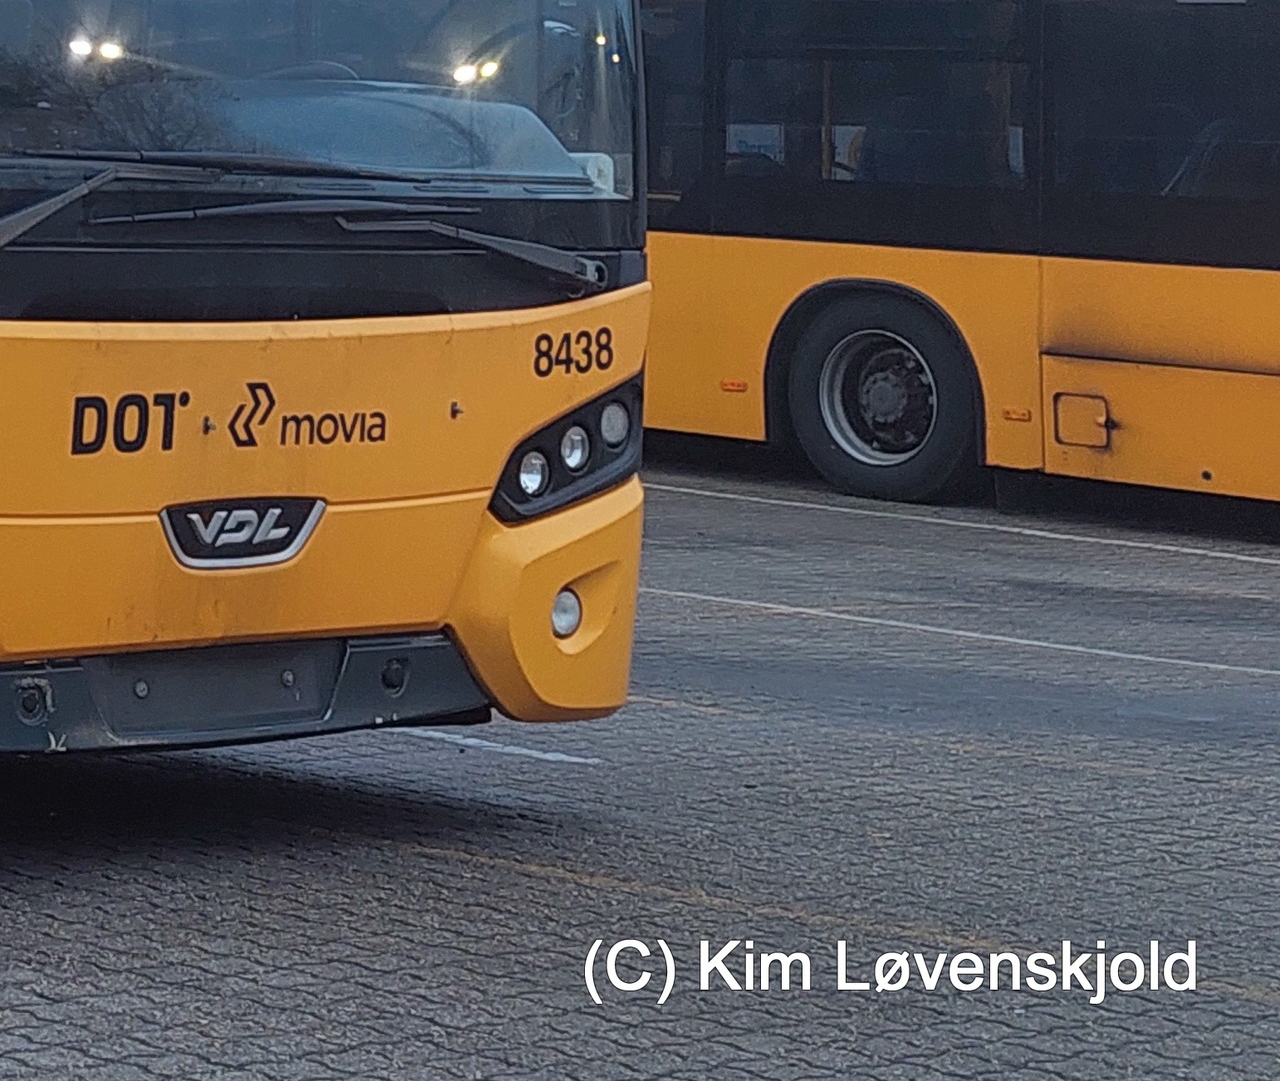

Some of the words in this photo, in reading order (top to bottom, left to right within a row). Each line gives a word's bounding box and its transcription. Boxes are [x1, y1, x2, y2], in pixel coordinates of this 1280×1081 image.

[533, 327, 614, 377] 8438
[71, 392, 190, 455] DOT
[280, 410, 387, 446] movia
[187, 507, 291, 547] VDL
